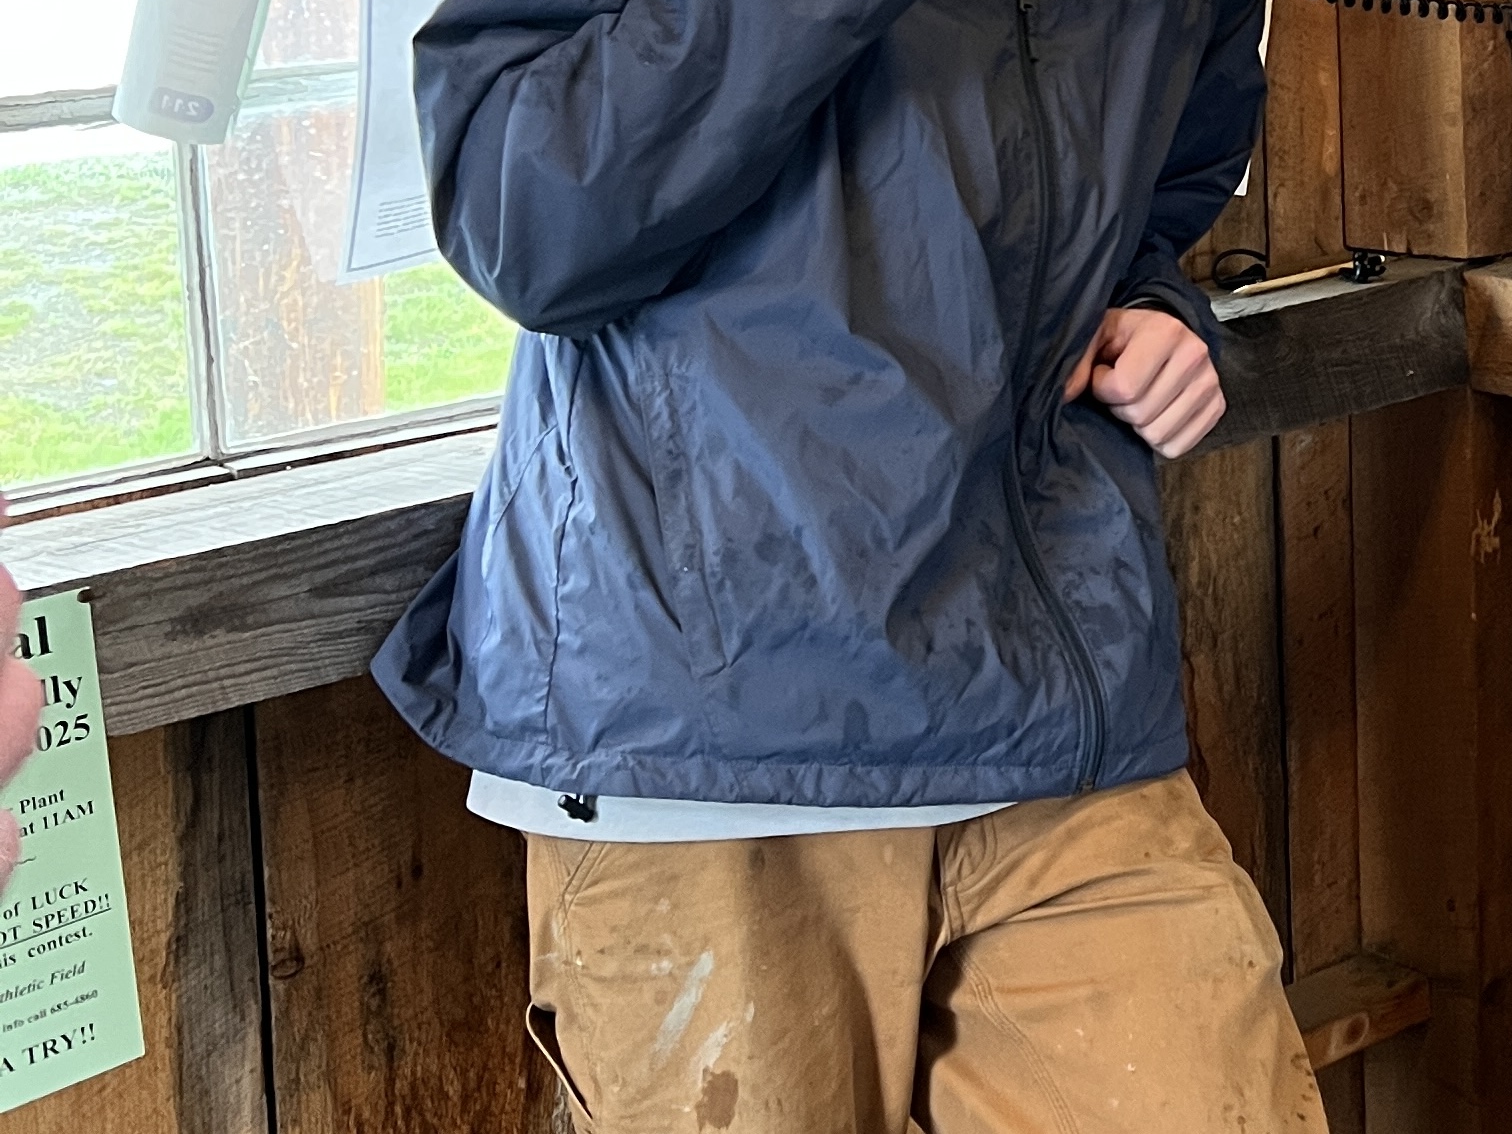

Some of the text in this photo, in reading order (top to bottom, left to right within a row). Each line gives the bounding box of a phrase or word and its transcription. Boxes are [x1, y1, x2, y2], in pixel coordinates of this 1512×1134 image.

[20, 789, 65, 814] Plant
[43, 801, 94, 830] 11AM
[31, 879, 88, 909] LUCK
[32, 893, 112, 935] SPEED!!
[28, 926, 93, 958] contest.
[50, 960, 86, 986] Field
[22, 1023, 96, 1065] TRY!!
